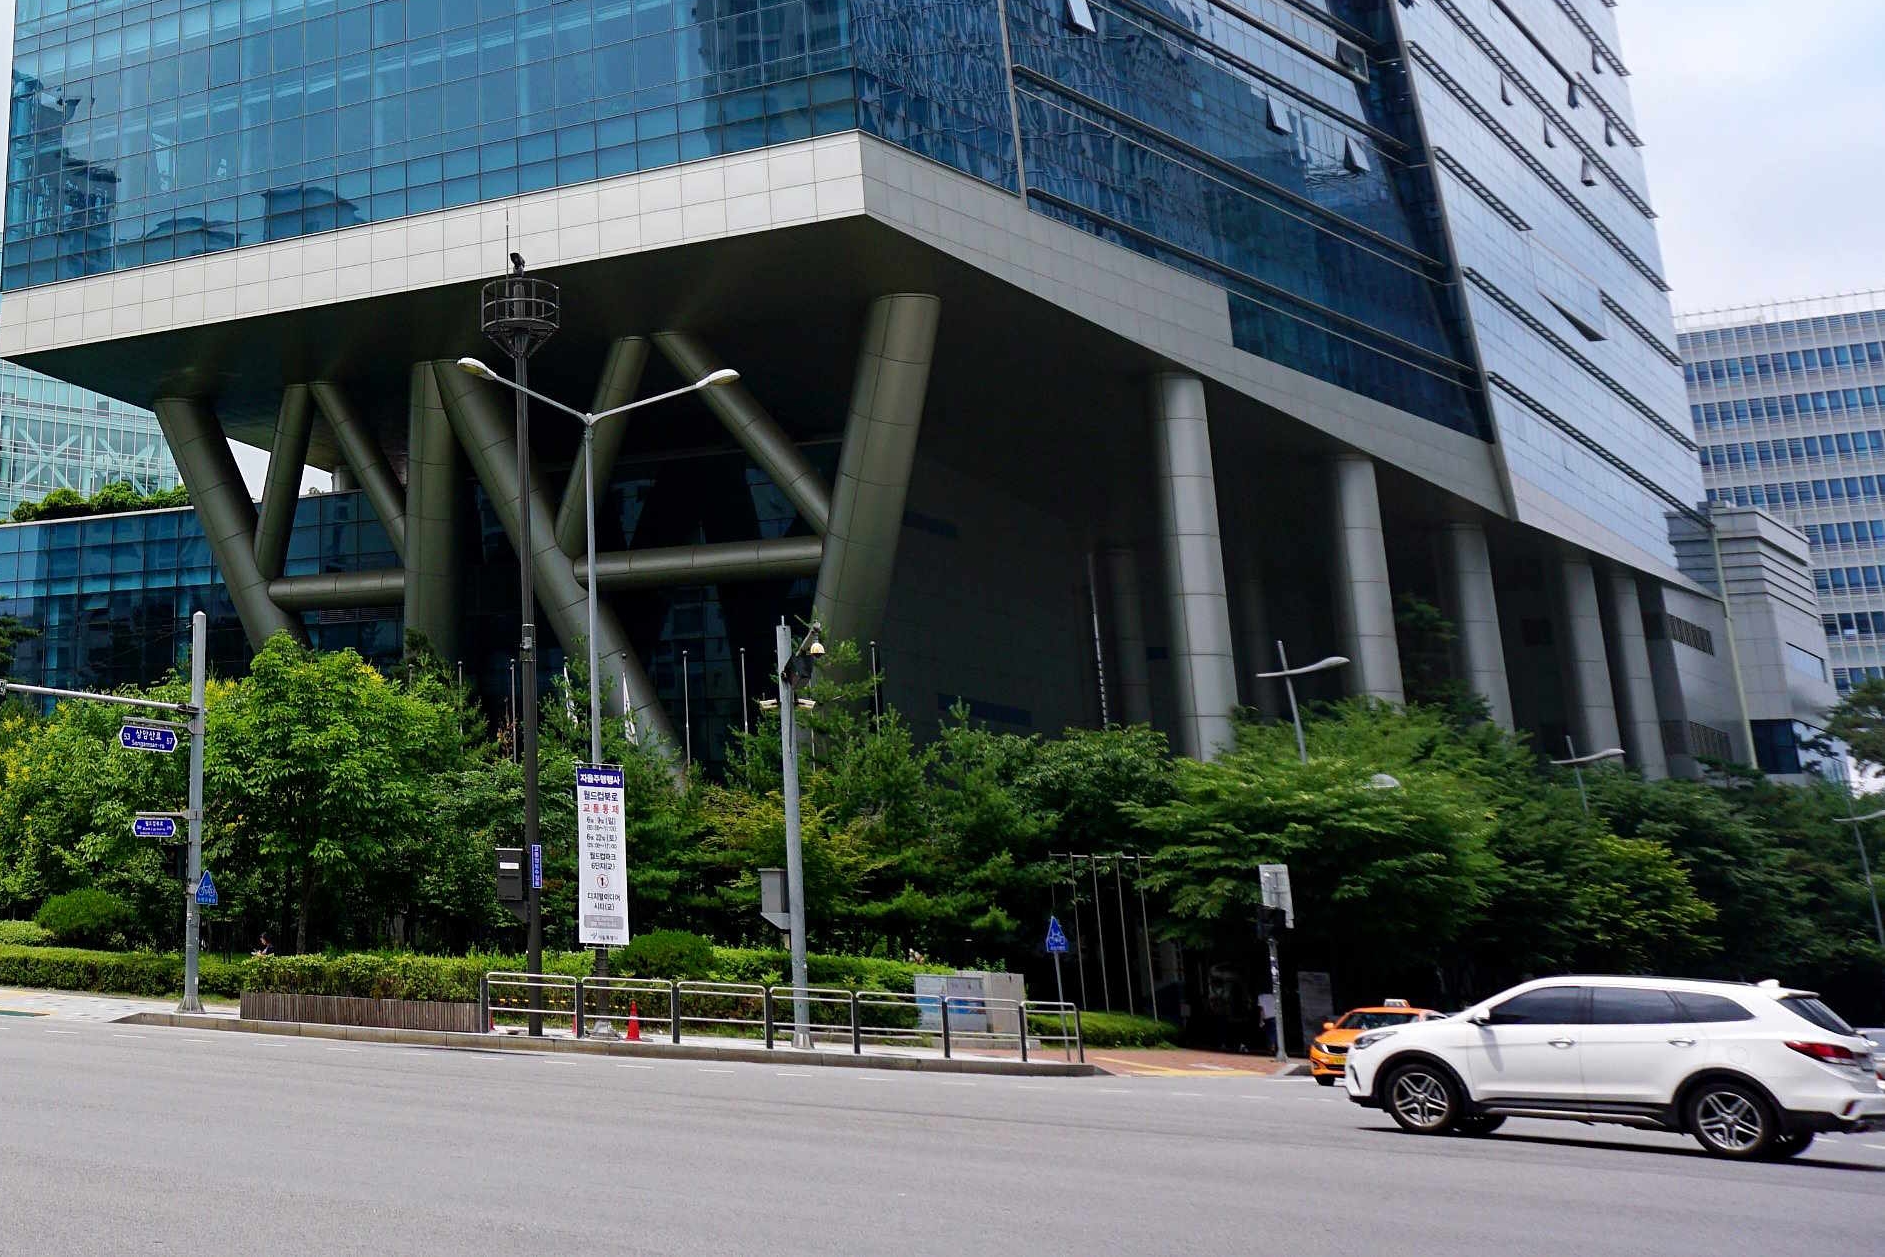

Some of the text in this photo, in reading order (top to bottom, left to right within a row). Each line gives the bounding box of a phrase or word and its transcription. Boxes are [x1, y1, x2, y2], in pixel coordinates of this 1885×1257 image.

[135, 729, 162, 741] 상암산로
[579, 773, 621, 785] 자율주행행사
[583, 790, 619, 802] 월드컵북로
